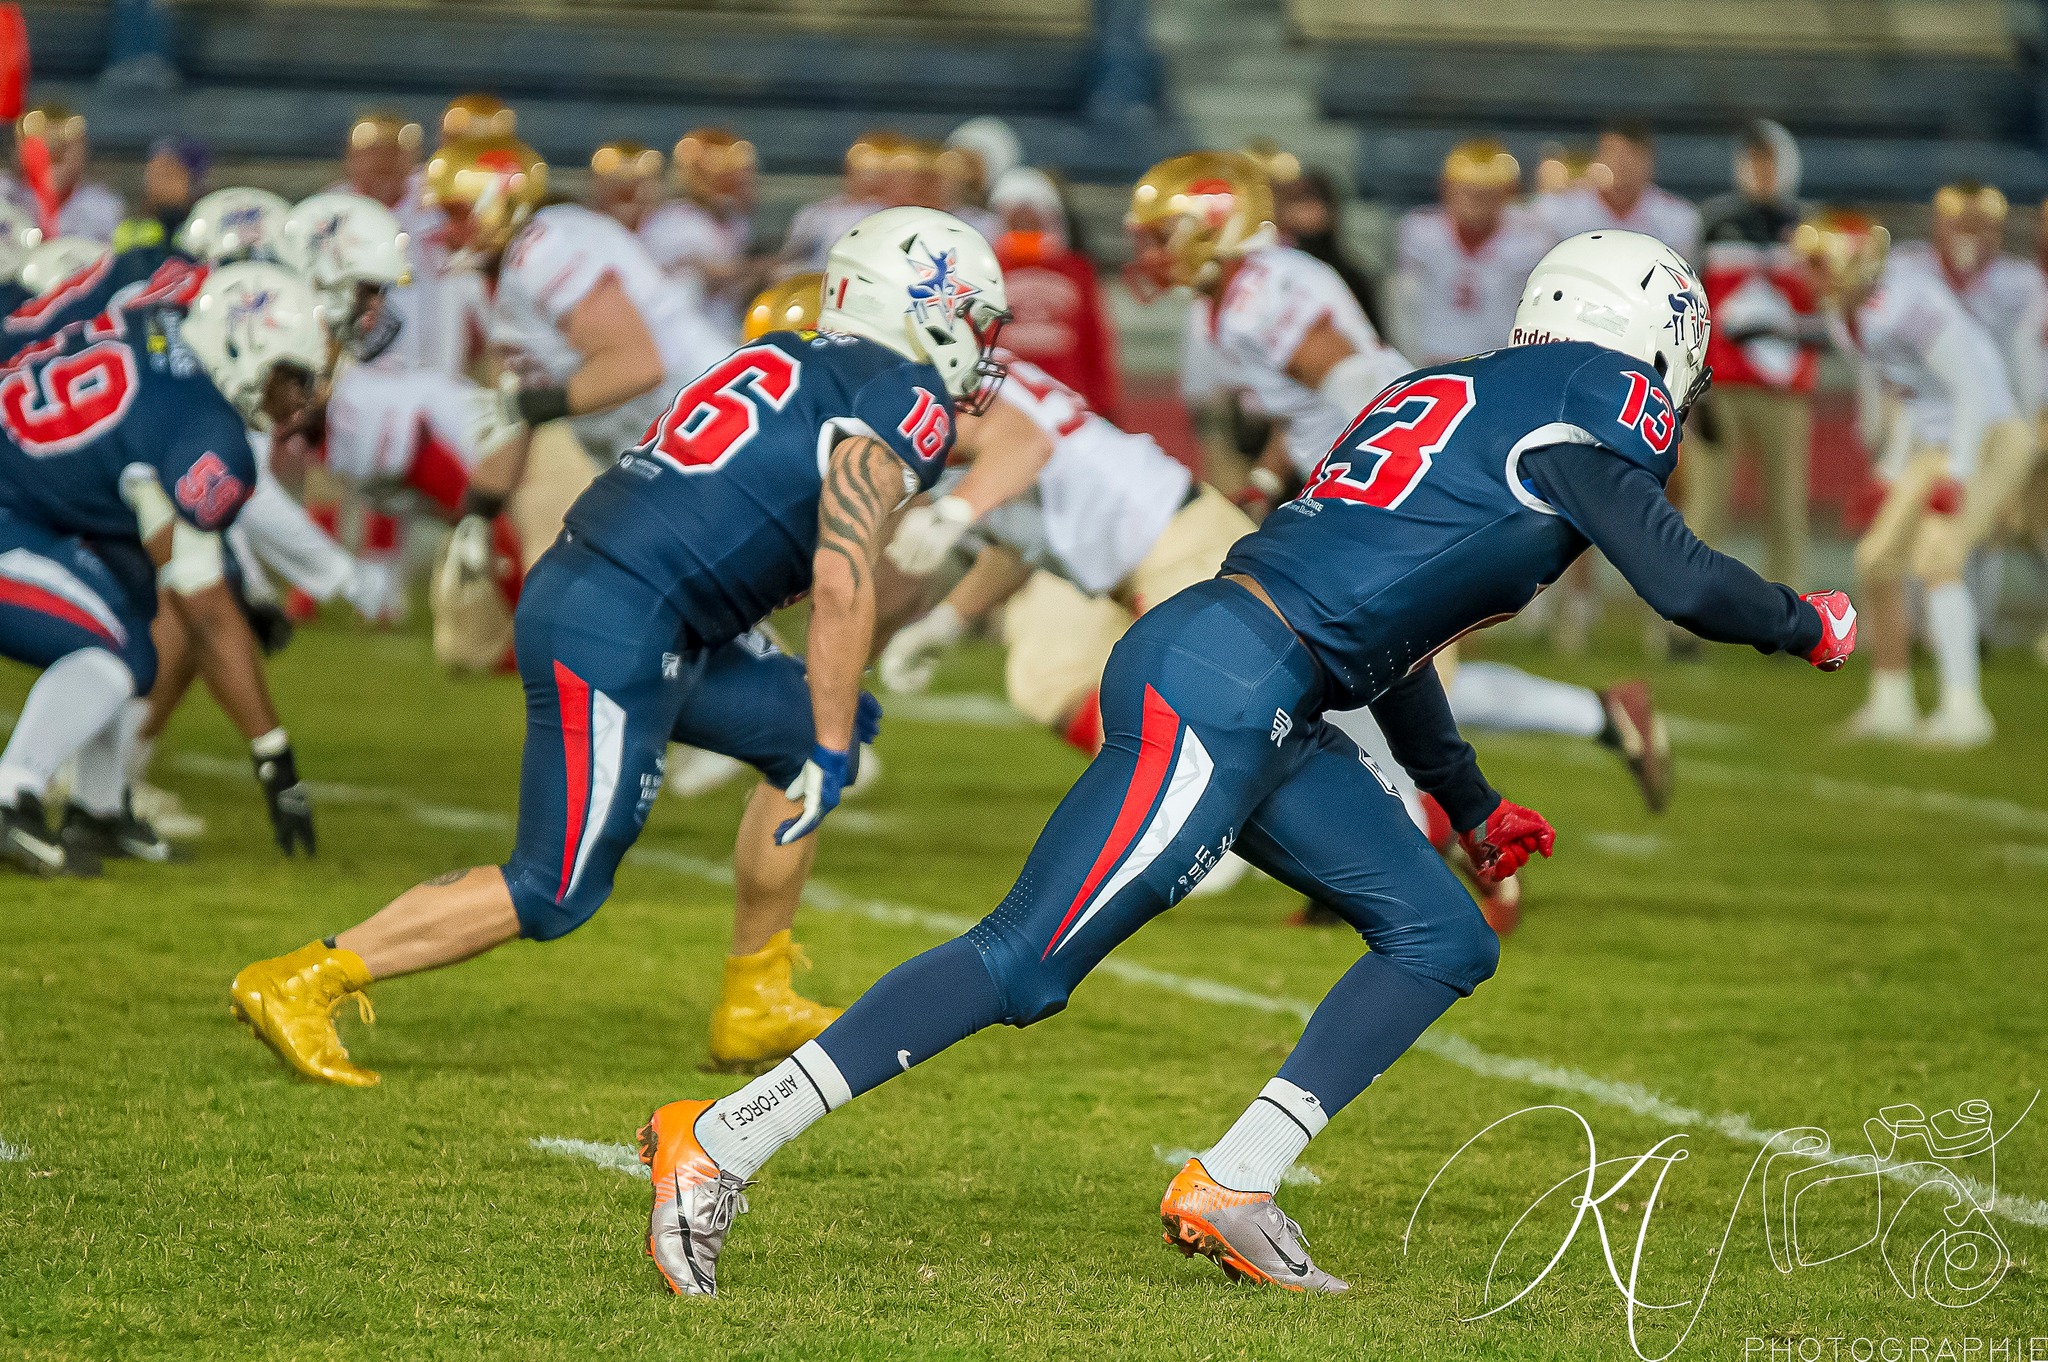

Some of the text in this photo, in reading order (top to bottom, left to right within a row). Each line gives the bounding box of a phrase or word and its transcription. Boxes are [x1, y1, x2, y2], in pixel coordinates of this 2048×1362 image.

[896, 386, 950, 462] 16
[1616, 370, 1676, 455] 13
[731, 1089, 780, 1127] FORCE
[774, 1074, 799, 1099] AIR
